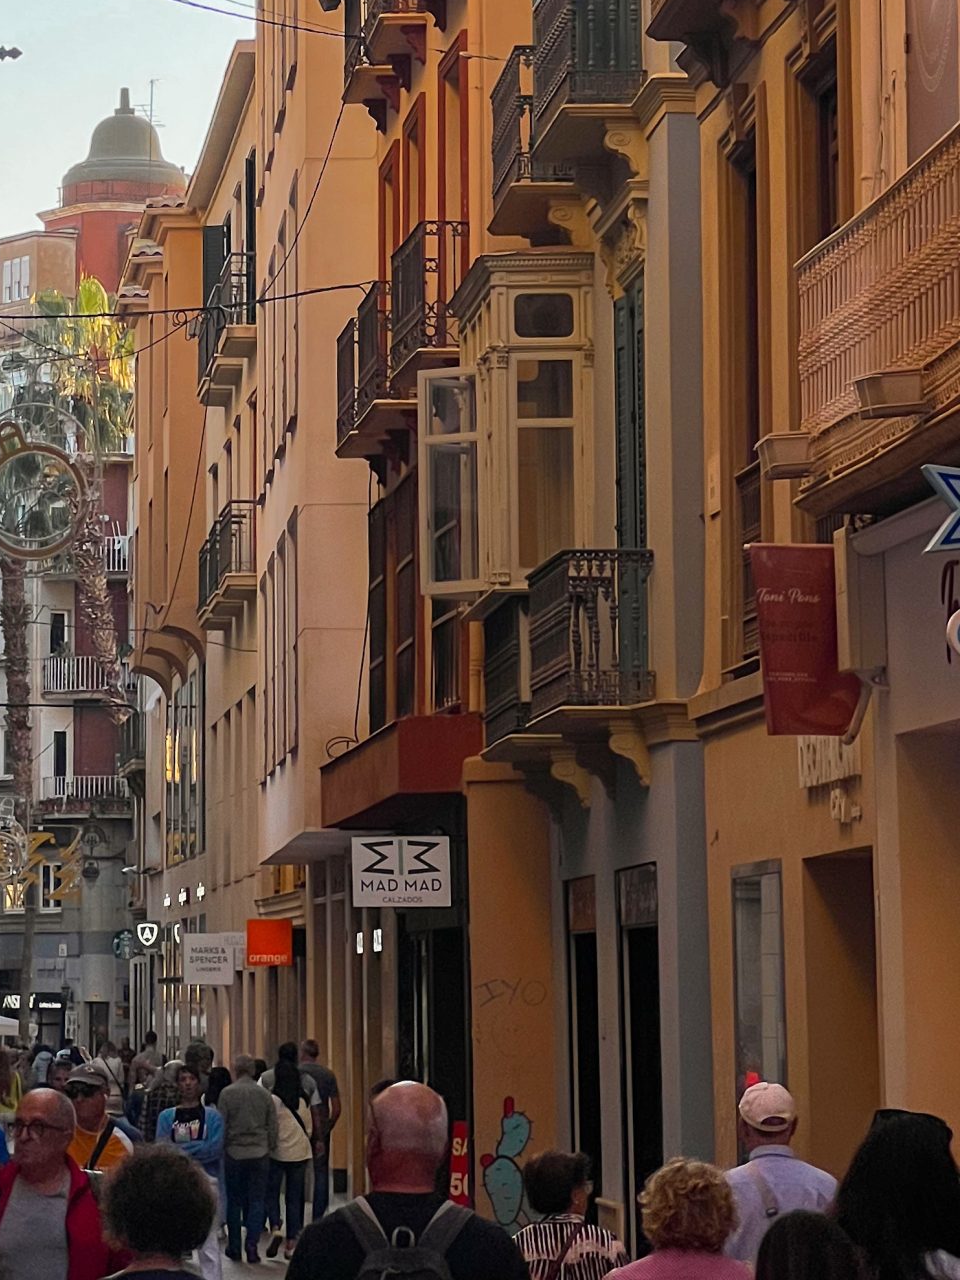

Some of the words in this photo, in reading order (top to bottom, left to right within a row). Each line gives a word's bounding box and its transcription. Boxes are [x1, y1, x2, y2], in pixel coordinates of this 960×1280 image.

[757, 587, 785, 603] Toni
[788, 587, 821, 605] Pons
[361, 879, 398, 892] MAD
[404, 879, 442, 892] MAD
[382, 896, 423, 904] CALZADOS
[191, 947, 219, 955] MARKS
[189, 956, 228, 965] SPENCER
[249, 953, 288, 965] orange
